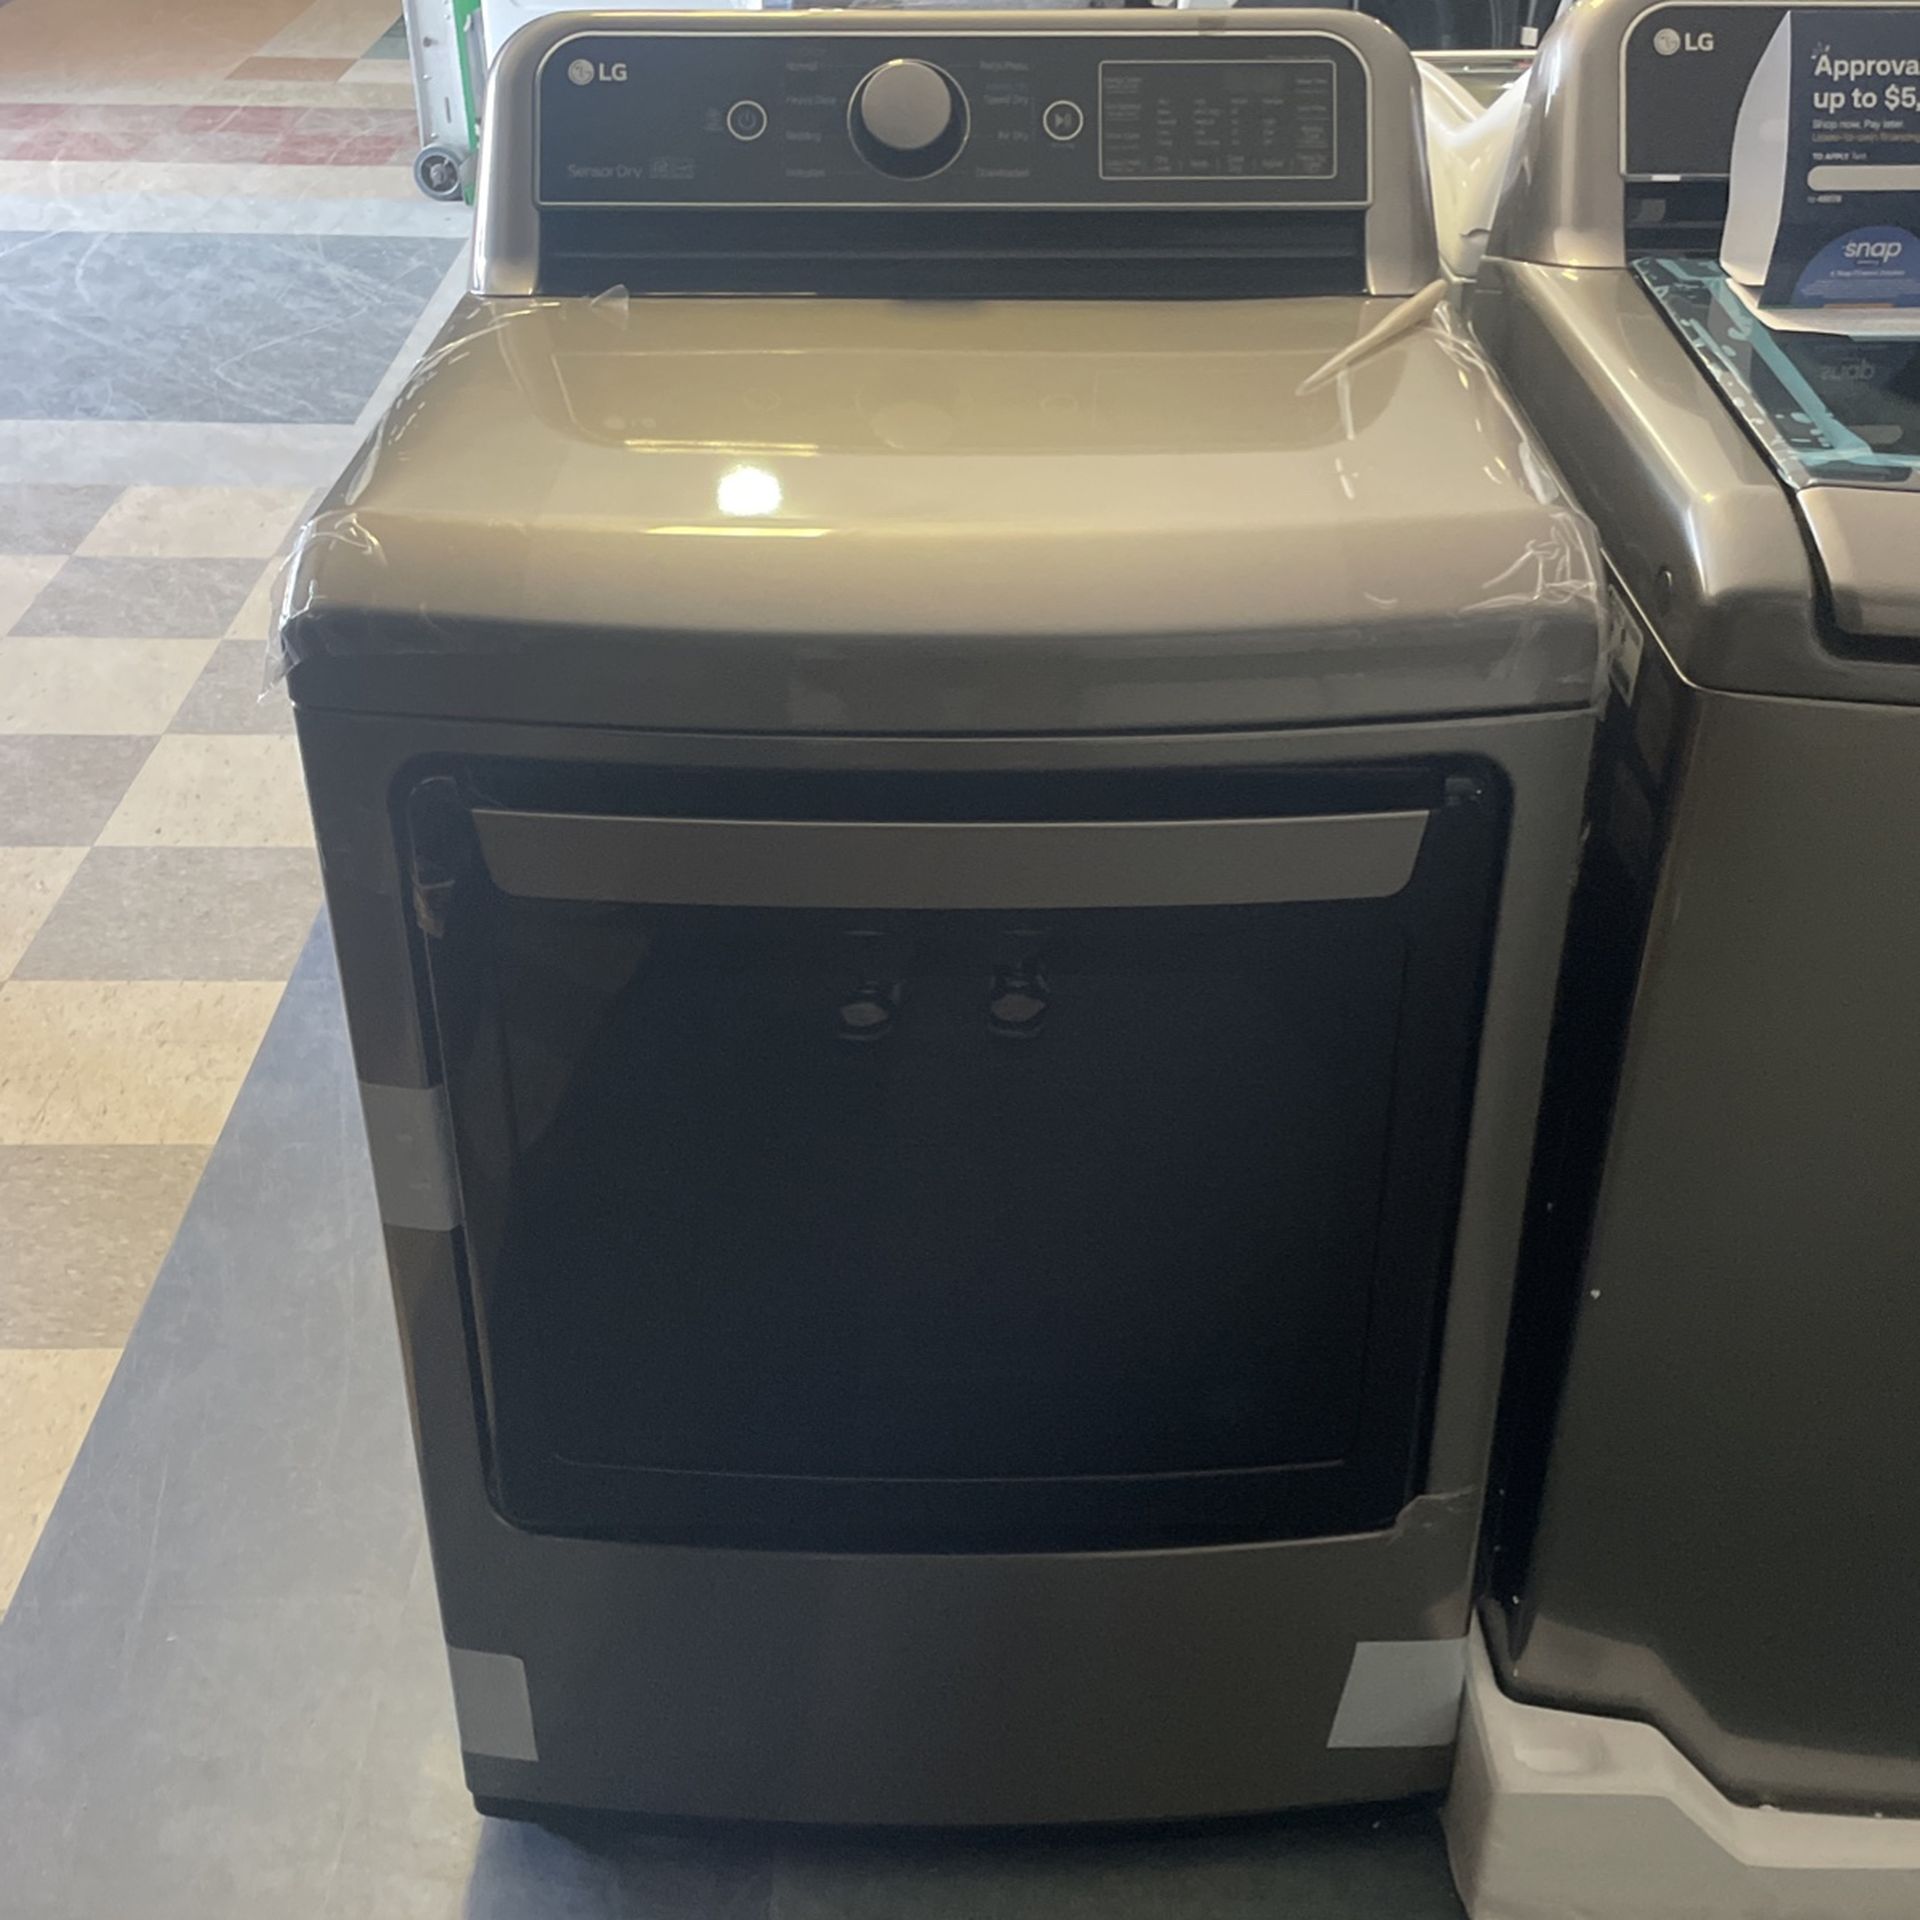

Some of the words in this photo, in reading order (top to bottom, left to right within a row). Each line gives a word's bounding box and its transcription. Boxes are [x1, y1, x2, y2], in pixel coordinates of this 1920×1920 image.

[1685, 33, 1714, 51] LG
[599, 63, 628, 81] LG
[1813, 92, 1845, 114] up
[1851, 88, 1877, 108] to
[1863, 119, 1881, 131] Pay
[1844, 241, 1903, 263] snap
